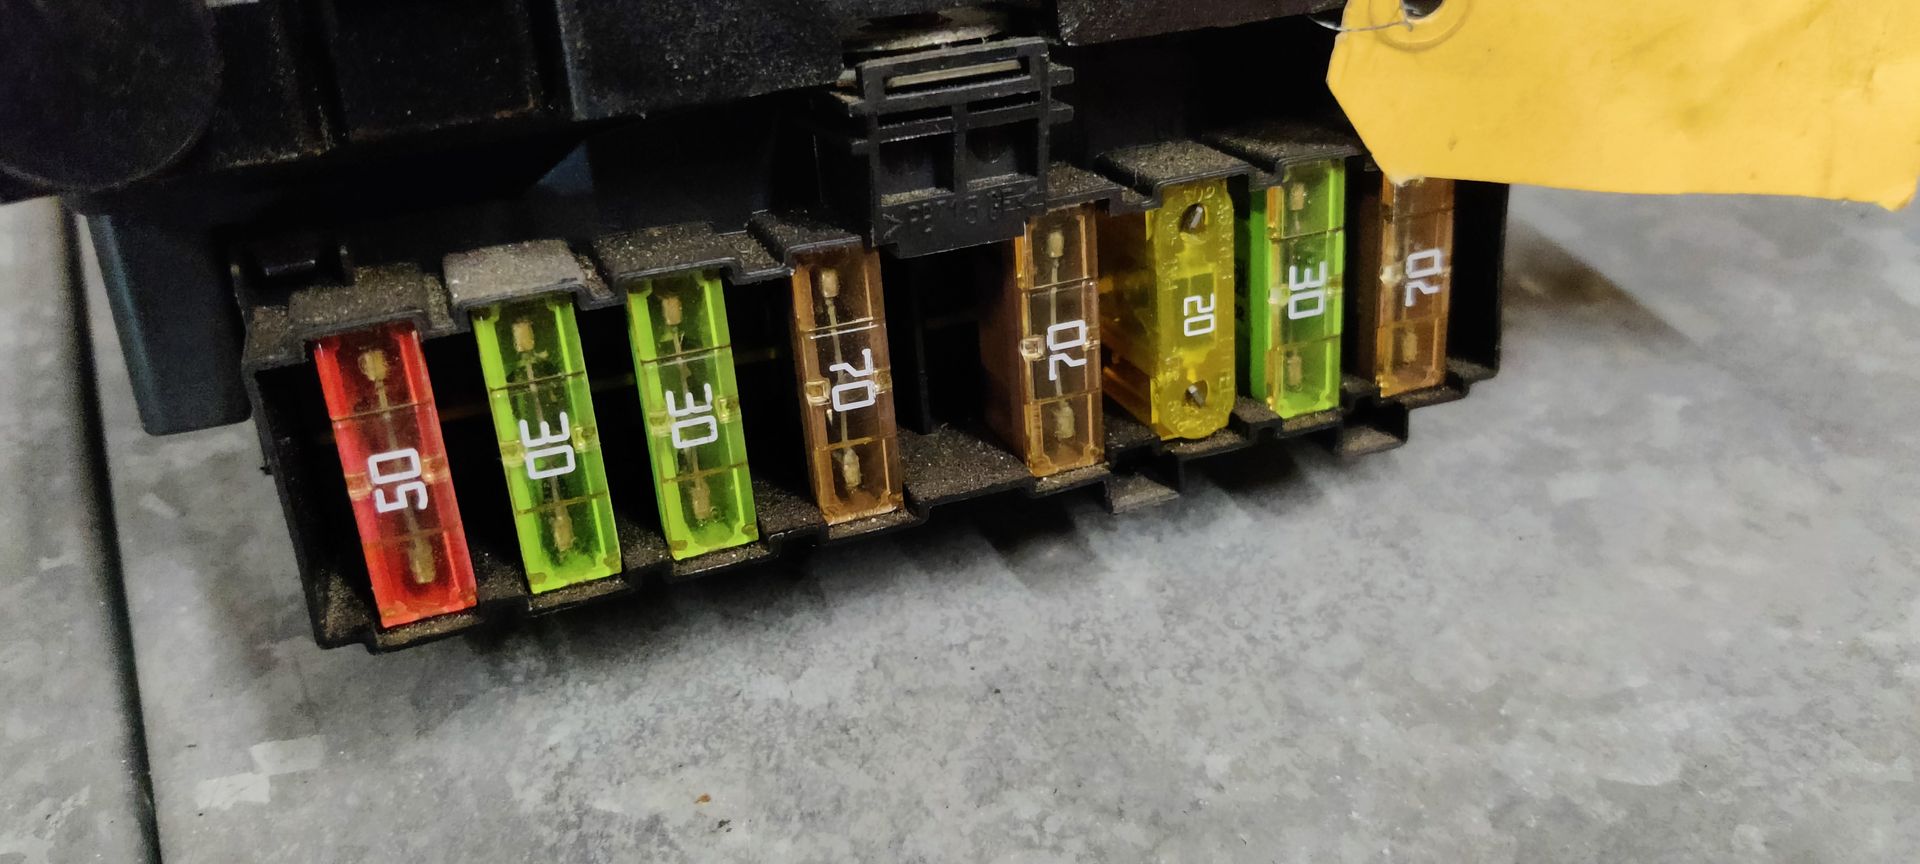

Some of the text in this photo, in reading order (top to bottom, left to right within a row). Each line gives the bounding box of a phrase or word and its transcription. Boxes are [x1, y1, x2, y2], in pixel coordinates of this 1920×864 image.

[1288, 262, 1326, 319] 30
[1405, 249, 1443, 306] 70
[1184, 294, 1215, 336] 20
[830, 349, 880, 411] 70
[1047, 320, 1090, 380] 70
[519, 412, 575, 479] 30
[666, 384, 718, 448] 30
[368, 448, 428, 513] 50
